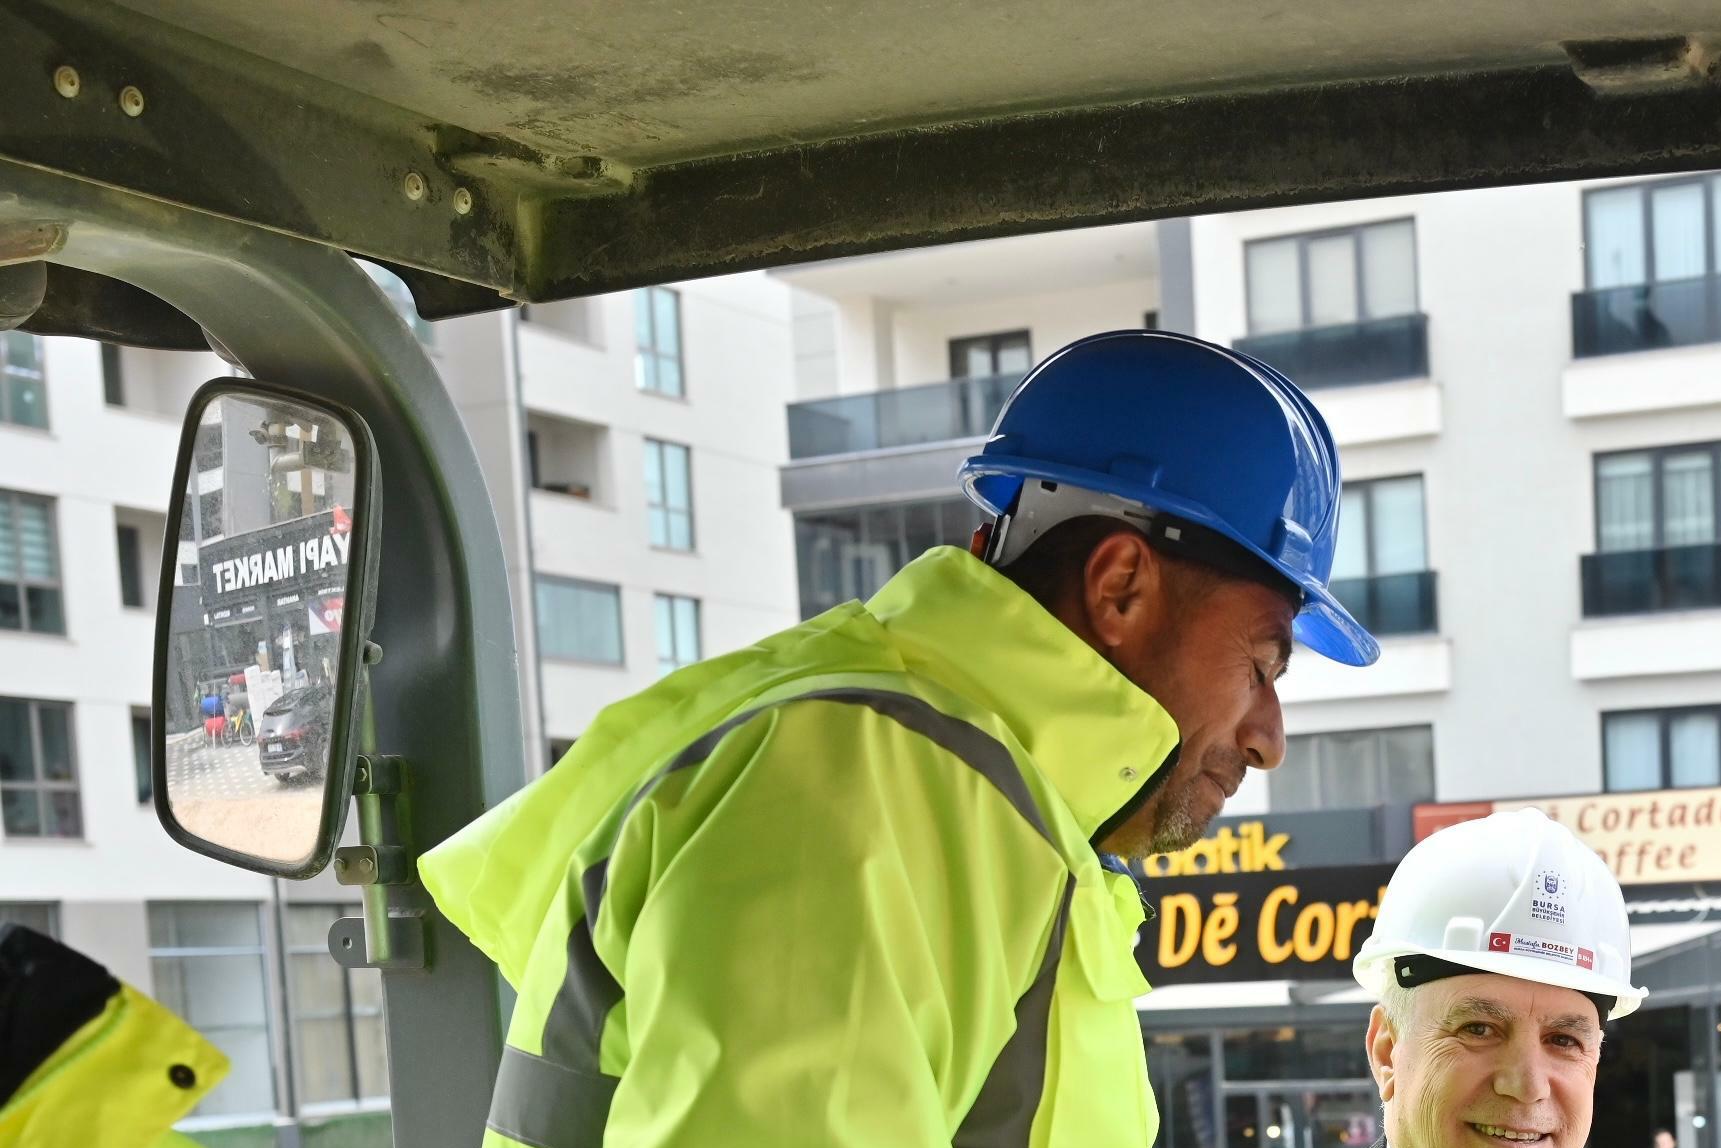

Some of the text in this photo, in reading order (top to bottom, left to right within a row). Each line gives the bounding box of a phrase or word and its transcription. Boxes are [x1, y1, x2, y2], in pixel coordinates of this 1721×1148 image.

[1594, 842, 1697, 876] ffee
[1532, 900, 1565, 913] BURSA
[1542, 942, 1574, 954] BOZBEY
